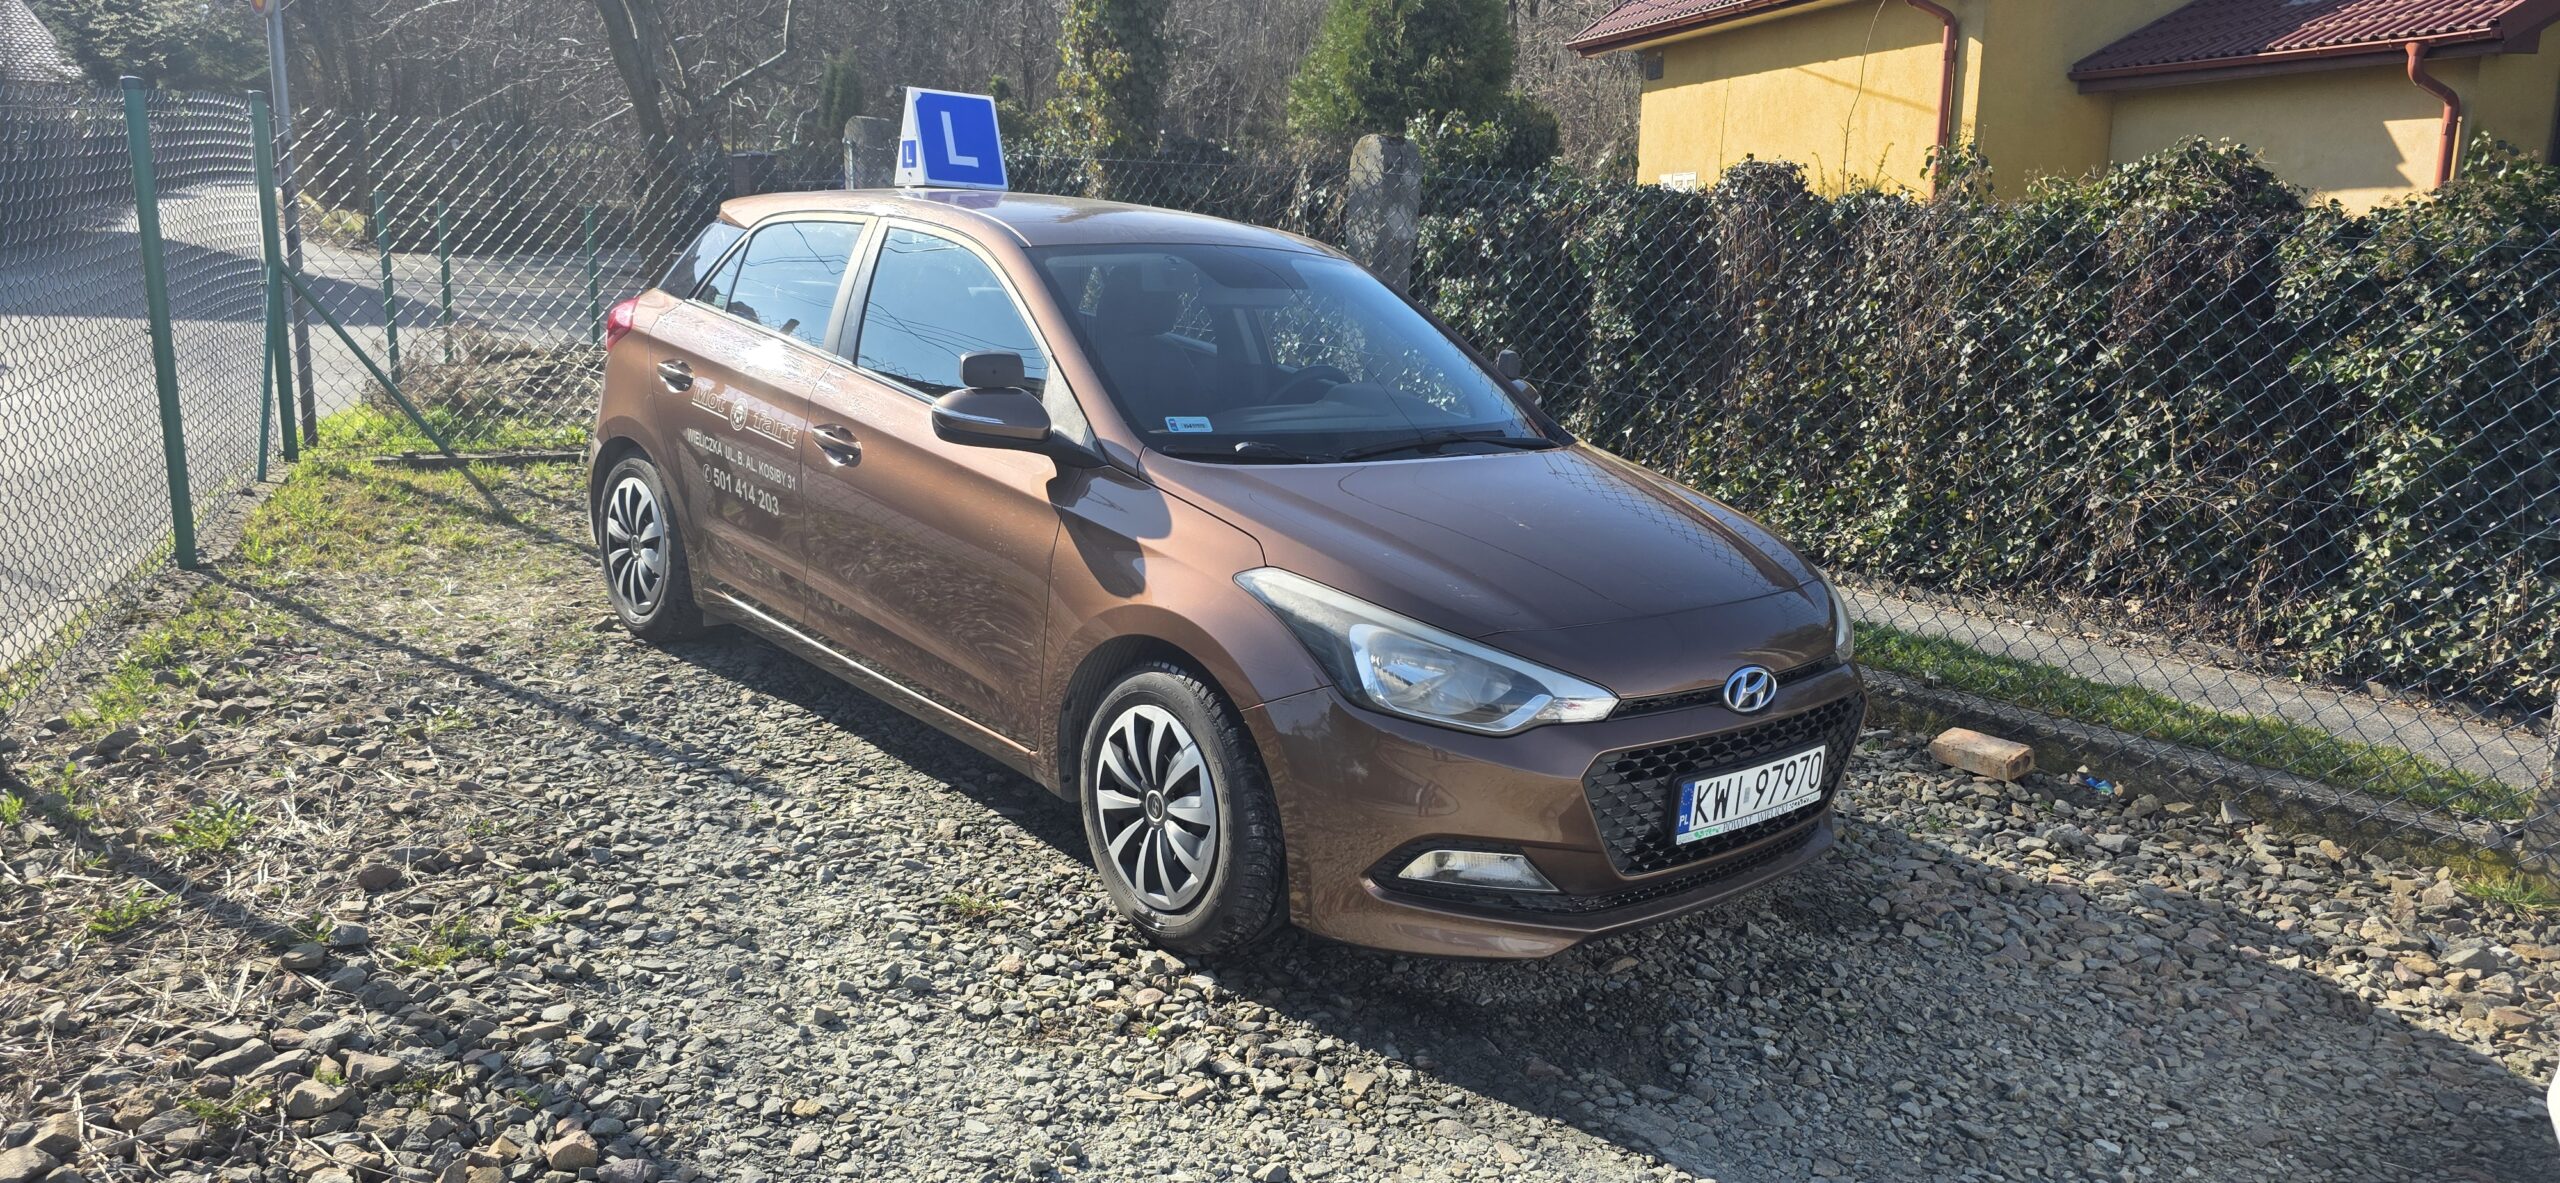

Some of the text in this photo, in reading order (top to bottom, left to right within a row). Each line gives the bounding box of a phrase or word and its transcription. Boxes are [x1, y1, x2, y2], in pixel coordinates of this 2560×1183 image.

[905, 144, 913, 163] L
[940, 110, 980, 168] L
[692, 385, 798, 444] Mot fart
[687, 427, 723, 457] WIELICZKA
[758, 460, 786, 488] KOSIBY
[787, 474, 796, 491] 31
[713, 467, 780, 516] 501 414 203
[1693, 751, 1822, 826] KWI 97970
[1678, 814, 1690, 827] PL
